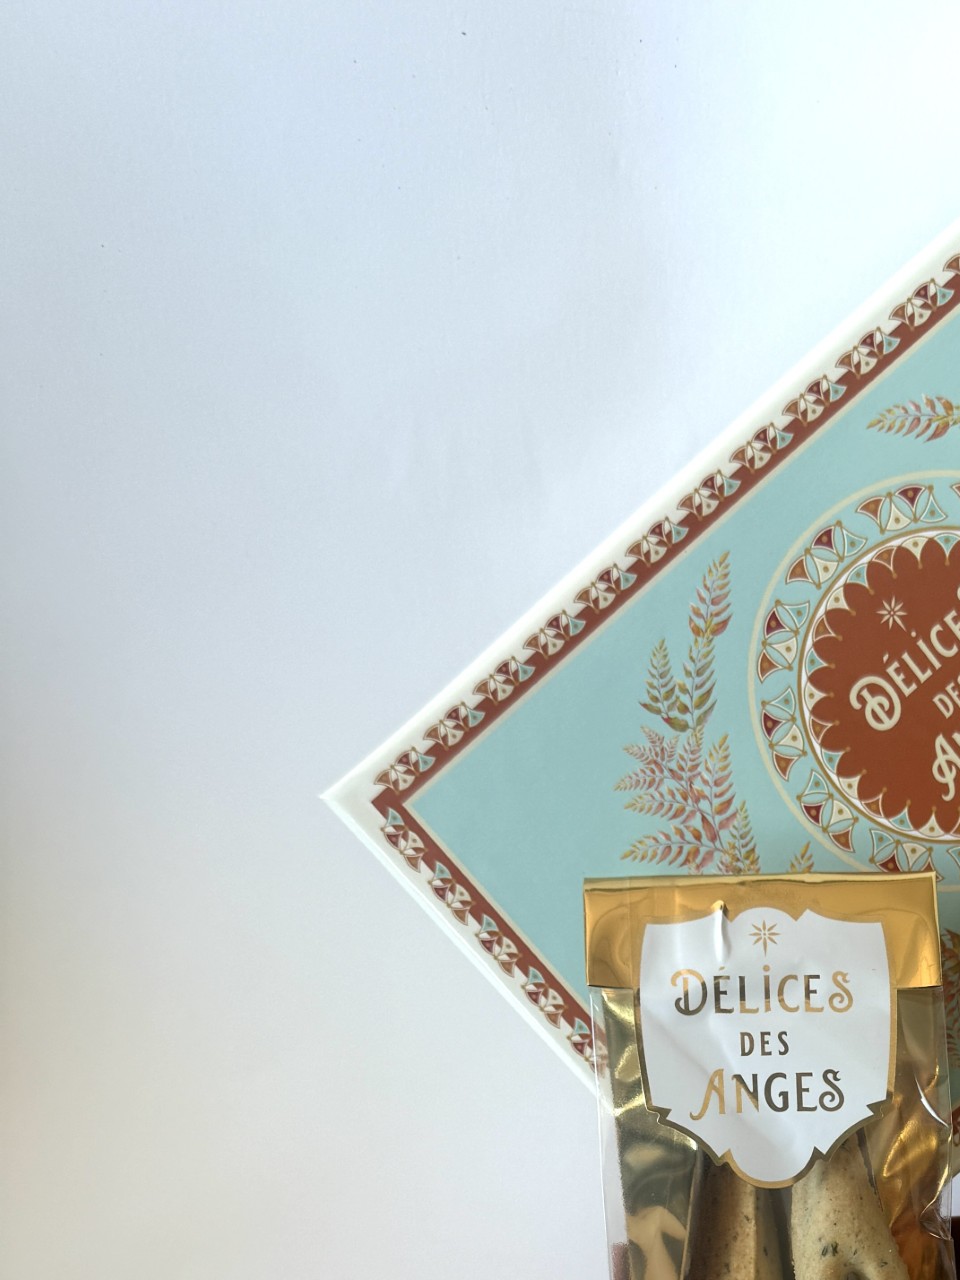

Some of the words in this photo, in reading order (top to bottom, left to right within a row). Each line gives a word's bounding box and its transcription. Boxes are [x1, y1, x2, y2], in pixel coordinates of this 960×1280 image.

[670, 964, 854, 1016] DÉLICES
[739, 1030, 790, 1057] DES
[689, 1068, 845, 1121] ANGES
